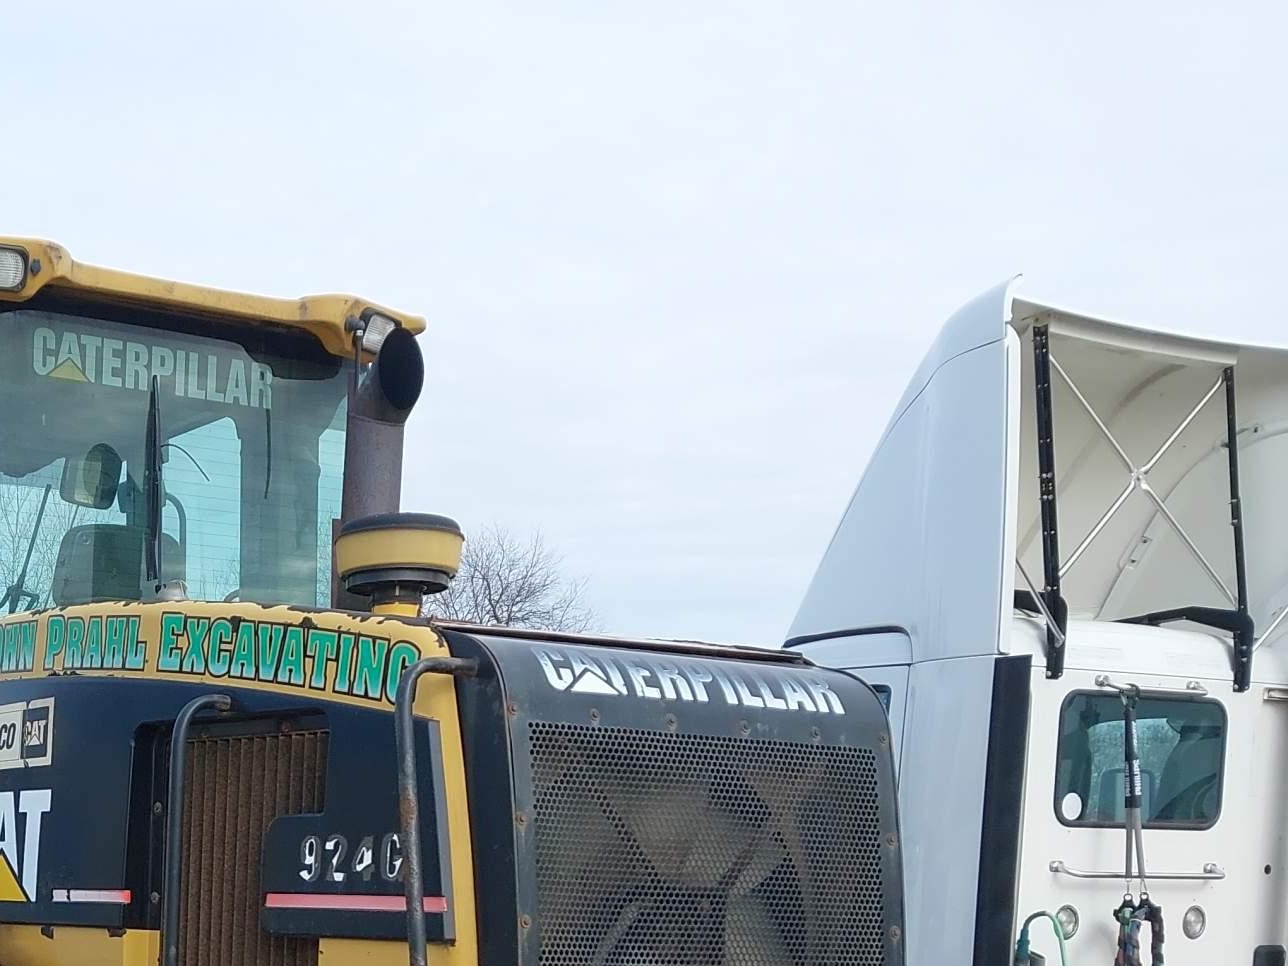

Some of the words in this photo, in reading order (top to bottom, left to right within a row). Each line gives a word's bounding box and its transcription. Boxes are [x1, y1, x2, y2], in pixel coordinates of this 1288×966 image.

[33, 327, 273, 409] CATERPILLAR
[42, 614, 147, 671] PRAHL
[531, 646, 846, 715] CATERPILLAR
[23, 719, 48, 746] CAT
[299, 833, 404, 881] 924G
